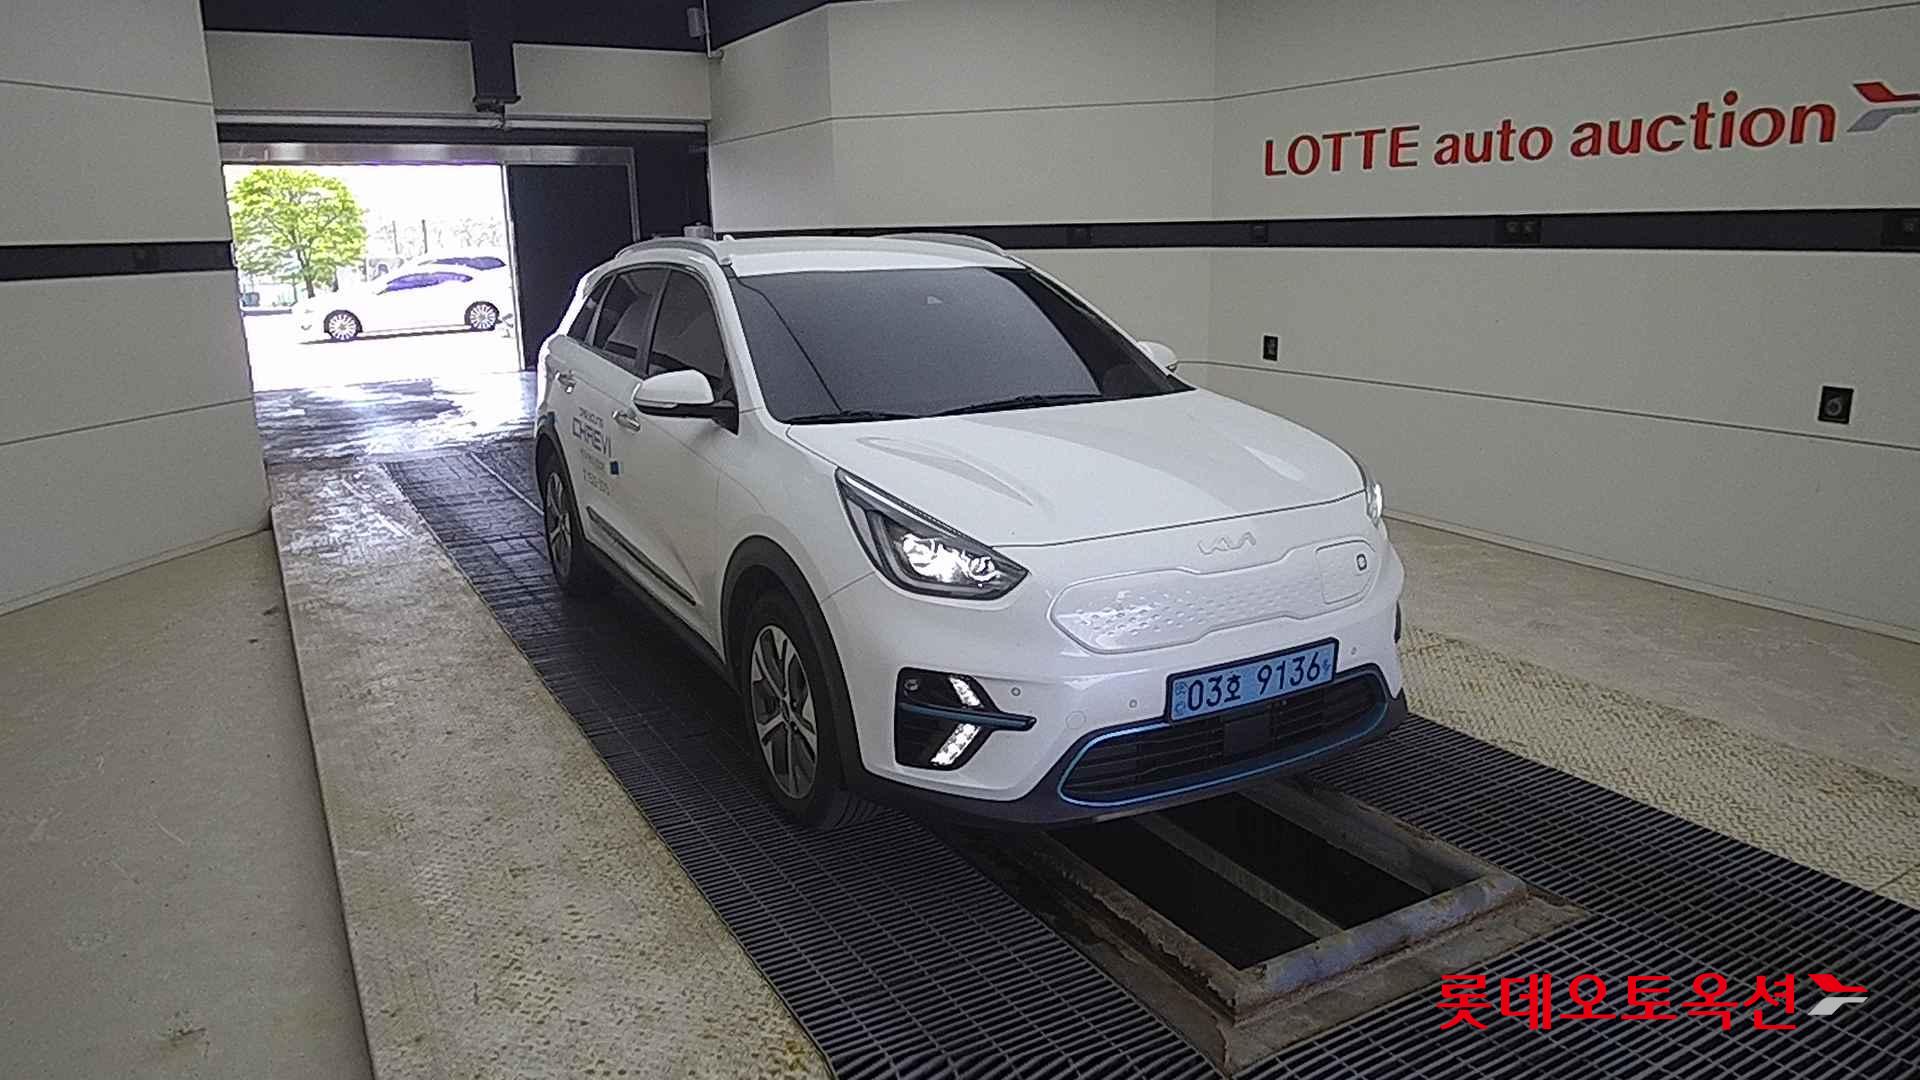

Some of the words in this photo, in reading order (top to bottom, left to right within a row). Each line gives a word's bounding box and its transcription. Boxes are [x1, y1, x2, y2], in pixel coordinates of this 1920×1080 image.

[1264, 125, 1420, 176] LOTTE
[1434, 118, 1554, 166] auto
[1570, 90, 1836, 158] auction
[1188, 673, 1241, 712] 03호
[1257, 652, 1321, 696] 9136
